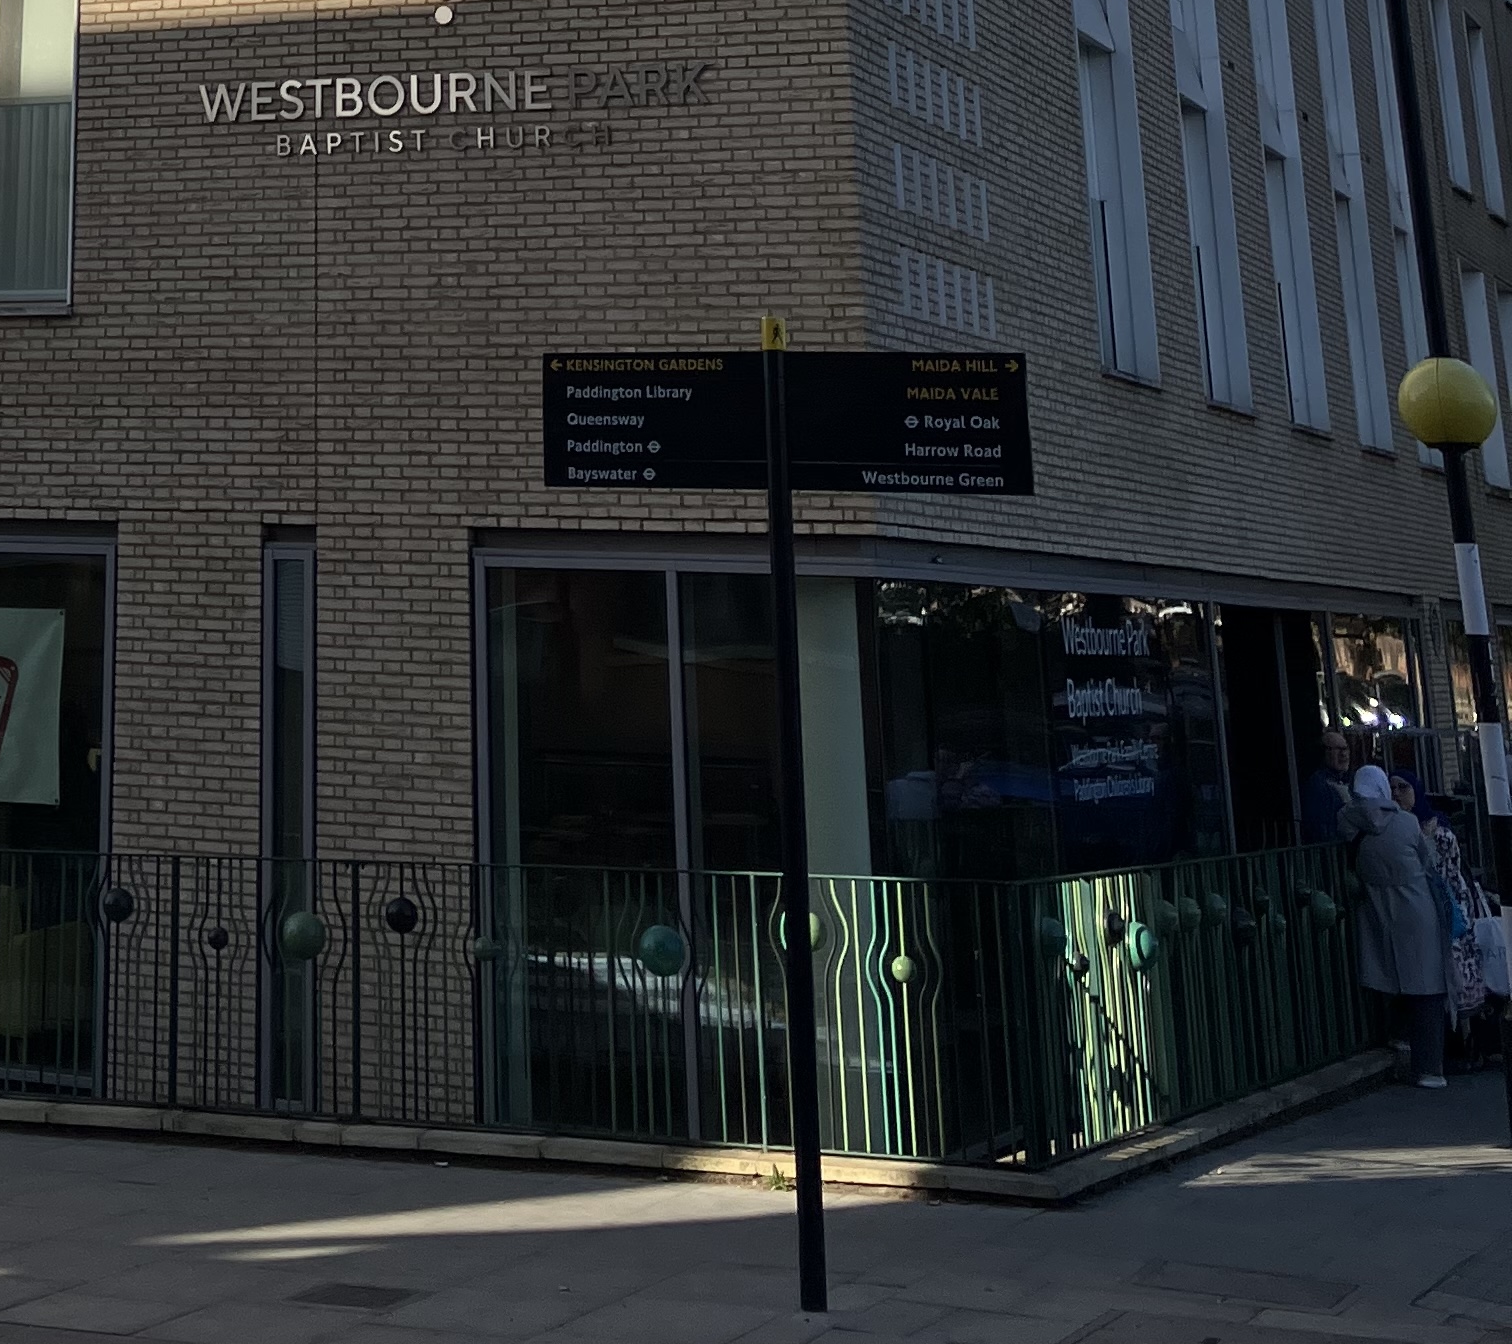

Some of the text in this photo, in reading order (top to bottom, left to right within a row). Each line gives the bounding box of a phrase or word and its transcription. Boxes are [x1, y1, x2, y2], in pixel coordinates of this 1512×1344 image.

[198, 61, 715, 124] WESTBOURNE PARK
[276, 123, 613, 158] BAPTIST CHURCH
[566, 358, 724, 372] KENSINGTON GARDENS
[911, 359, 998, 373] MAIDA HILL
[566, 385, 693, 402] Paddington Library
[906, 387, 1000, 401] MAIDA VALE
[566, 412, 645, 429] Queensway
[924, 415, 1001, 432] Royal Oak
[566, 439, 643, 456] Paddington
[904, 442, 1002, 459] Harrow Road
[567, 466, 638, 483] Bayswater
[861, 470, 1005, 488] Westbourne Green
[1060, 614, 1151, 657] Westbourne Park
[1067, 676, 1143, 727] Baptist Church
